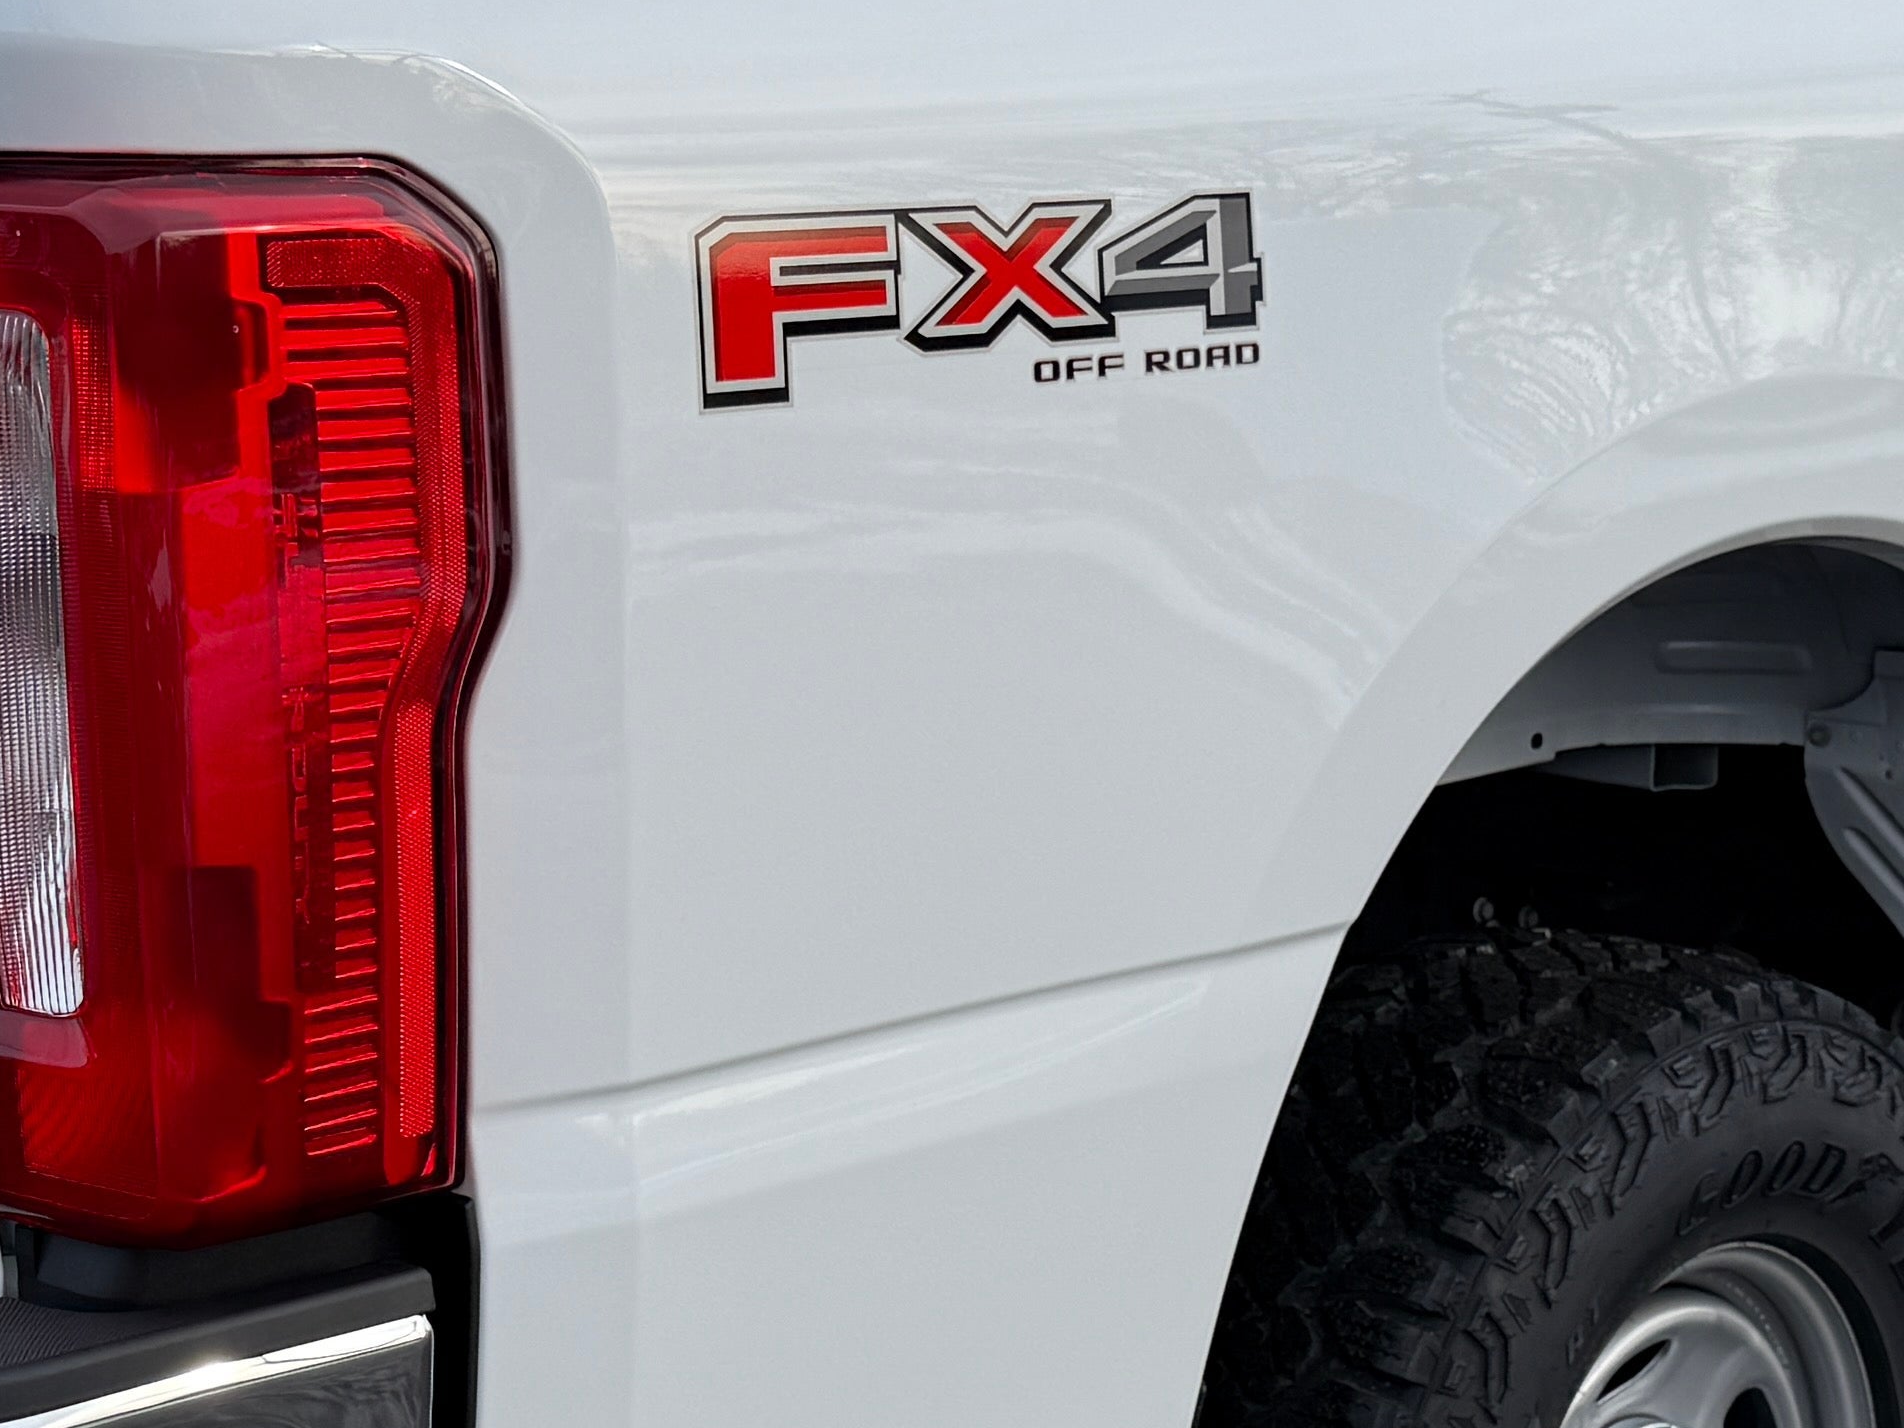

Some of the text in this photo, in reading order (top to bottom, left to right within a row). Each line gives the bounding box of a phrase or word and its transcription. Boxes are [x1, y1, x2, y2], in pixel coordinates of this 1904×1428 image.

[695, 191, 1264, 412] FX4
[1033, 342, 1260, 383] OFF ROAD
